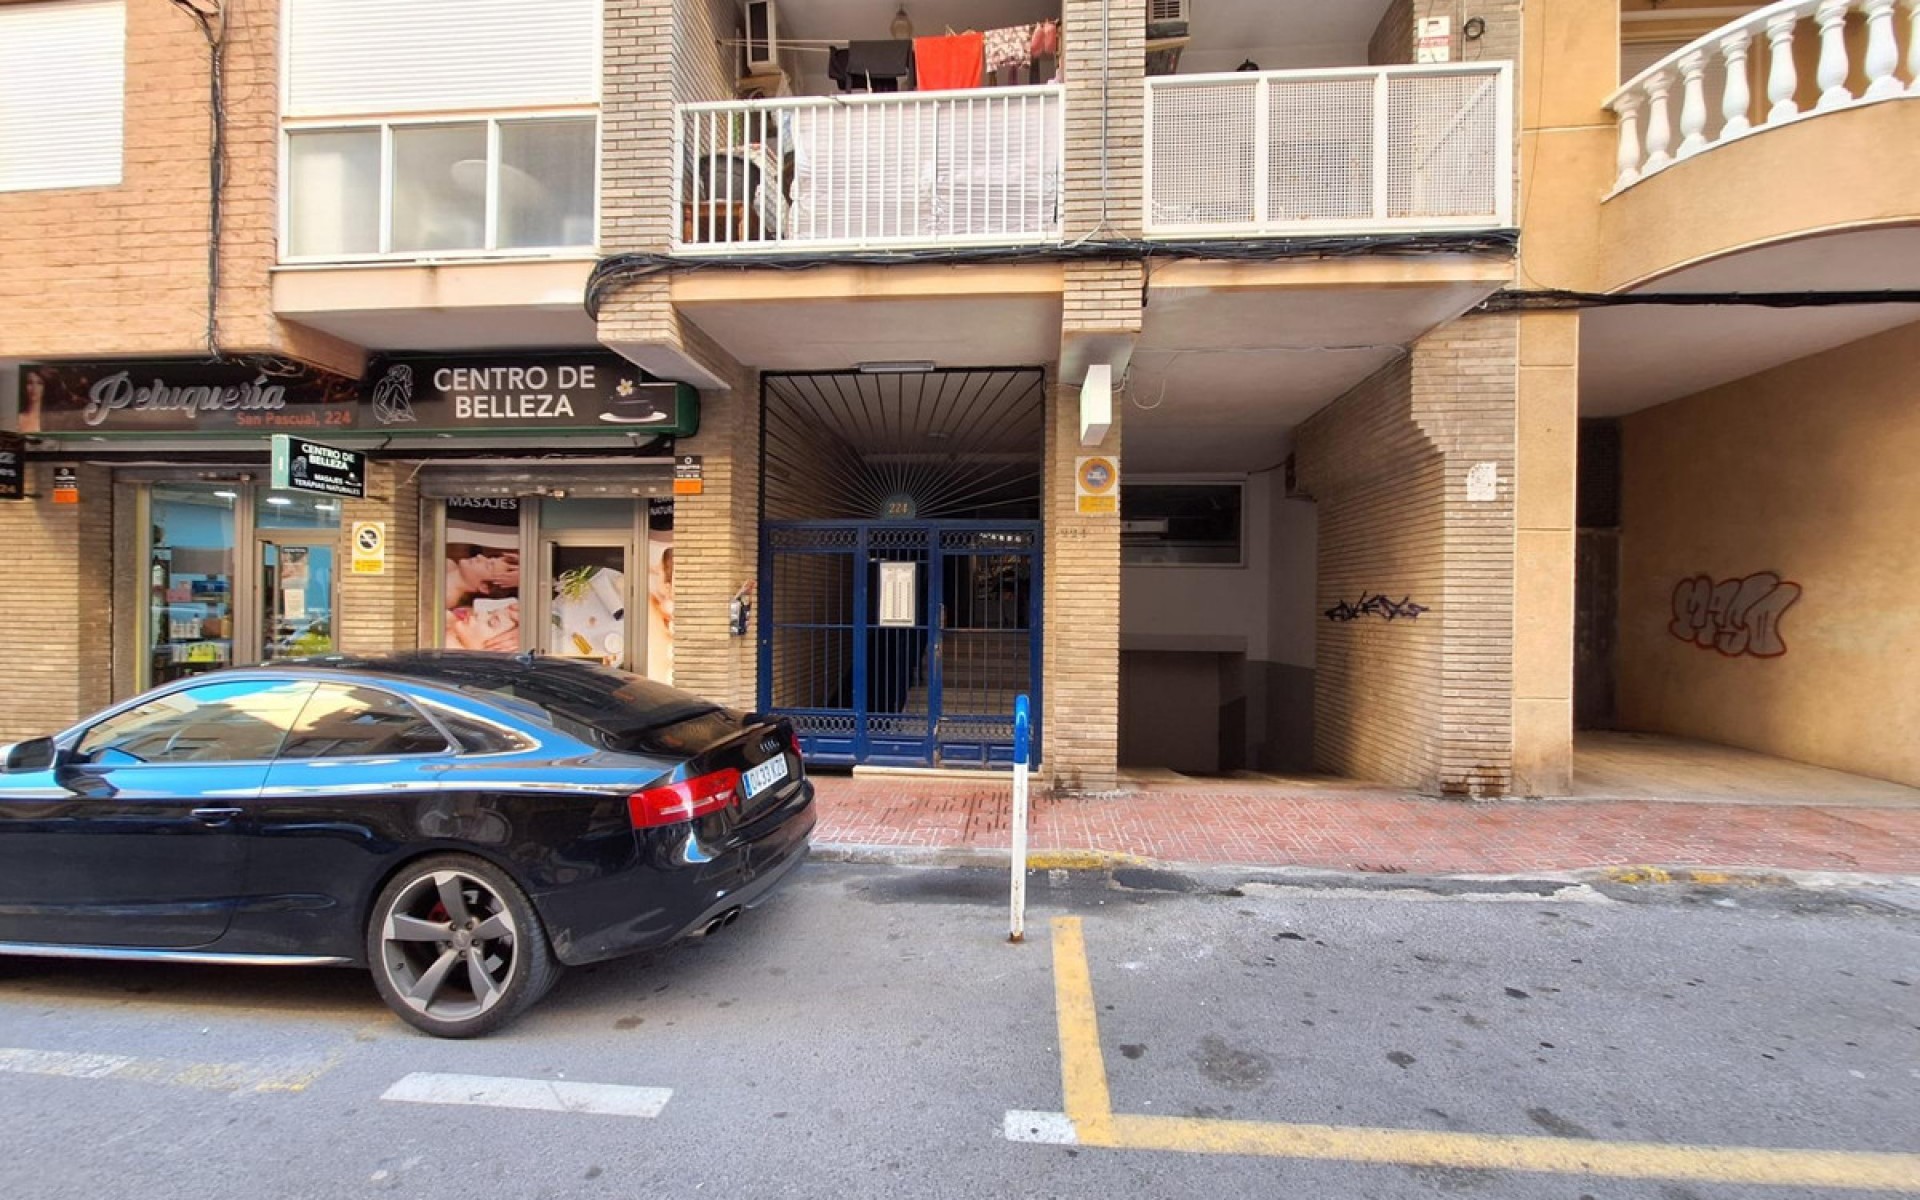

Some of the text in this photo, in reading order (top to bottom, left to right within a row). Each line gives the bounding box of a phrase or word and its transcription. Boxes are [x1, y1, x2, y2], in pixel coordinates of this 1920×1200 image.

[433, 365, 596, 391] CENTRO DE
[84, 371, 286, 425] Peluquería
[455, 394, 575, 419] BELLEZA
[236, 411, 262, 426] San
[324, 410, 353, 425] 224
[302, 443, 355, 463] CENTRO DE
[308, 455, 349, 470] BELLEZA
[314, 473, 343, 485] MASAJES
[448, 496, 518, 510] MASAJES
